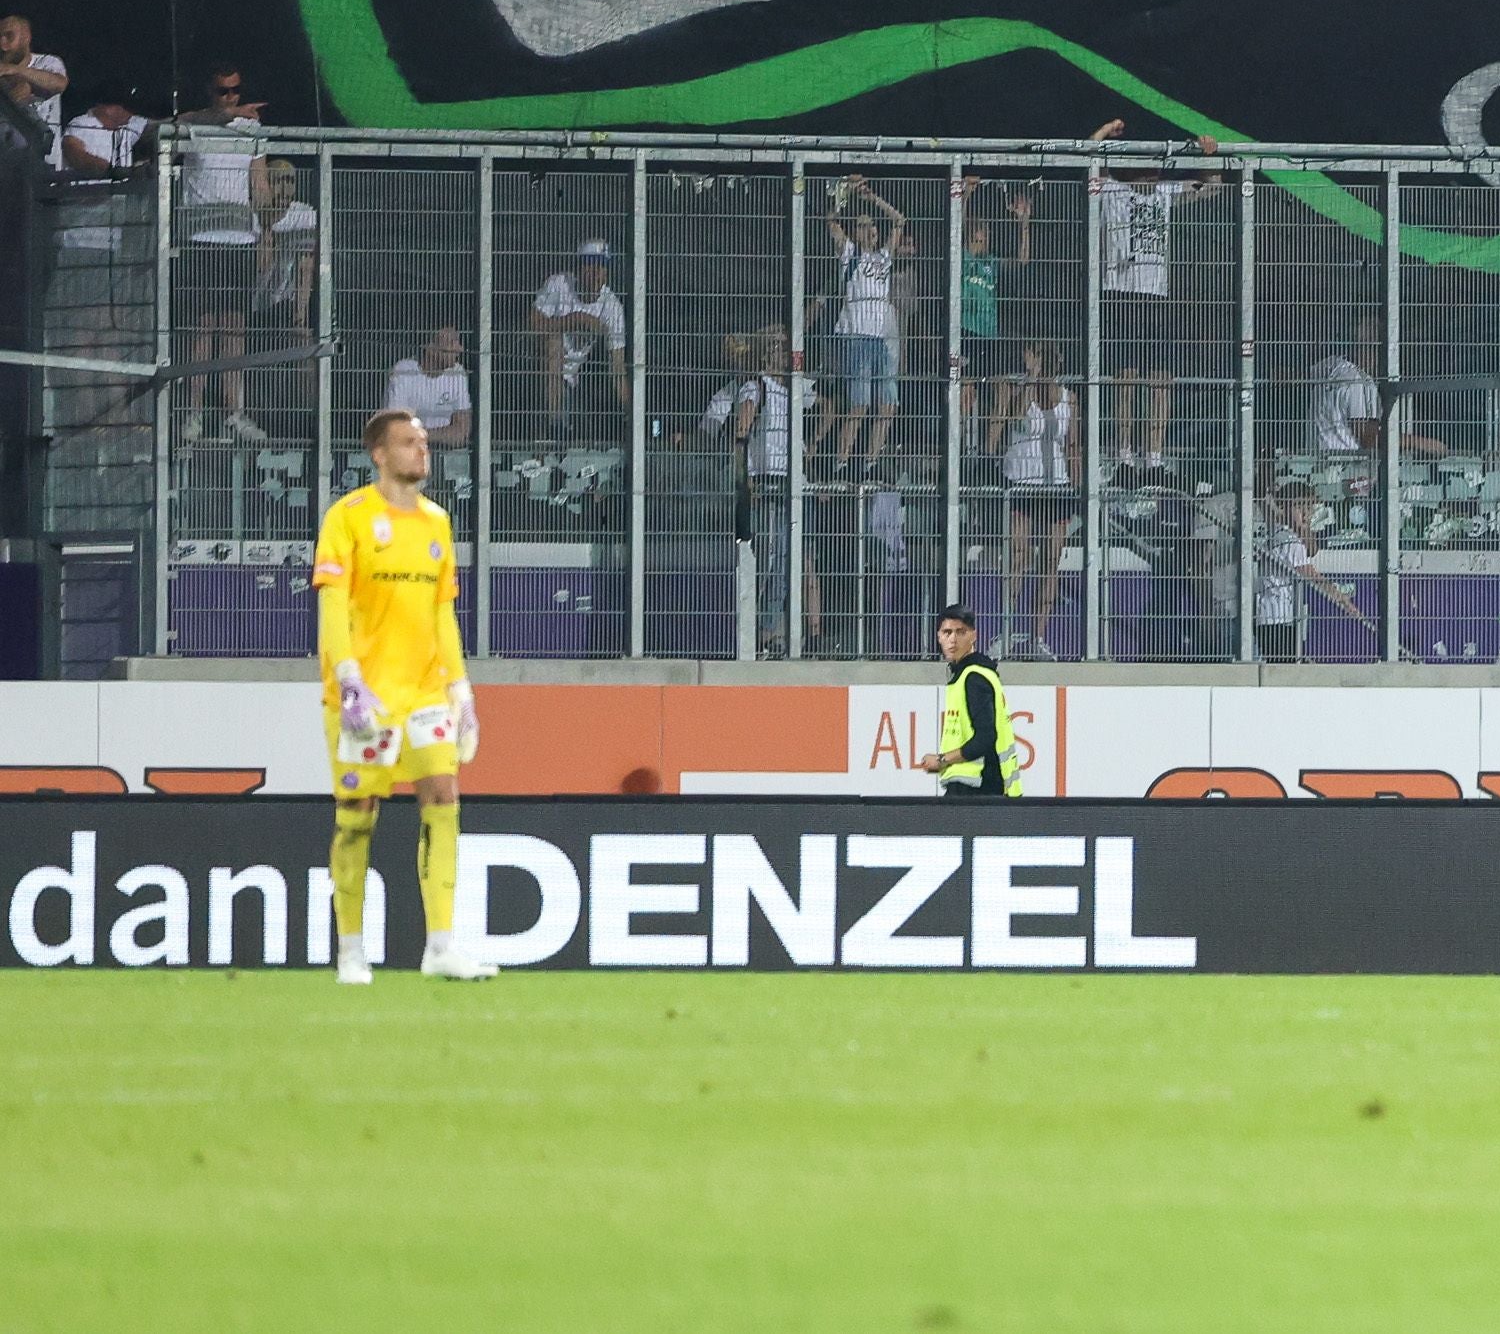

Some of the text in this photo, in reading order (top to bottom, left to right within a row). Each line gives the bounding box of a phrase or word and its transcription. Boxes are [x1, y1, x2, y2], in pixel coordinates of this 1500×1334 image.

[868, 710, 1035, 771] ALS
[7, 830, 1198, 969] dann DENZEL
